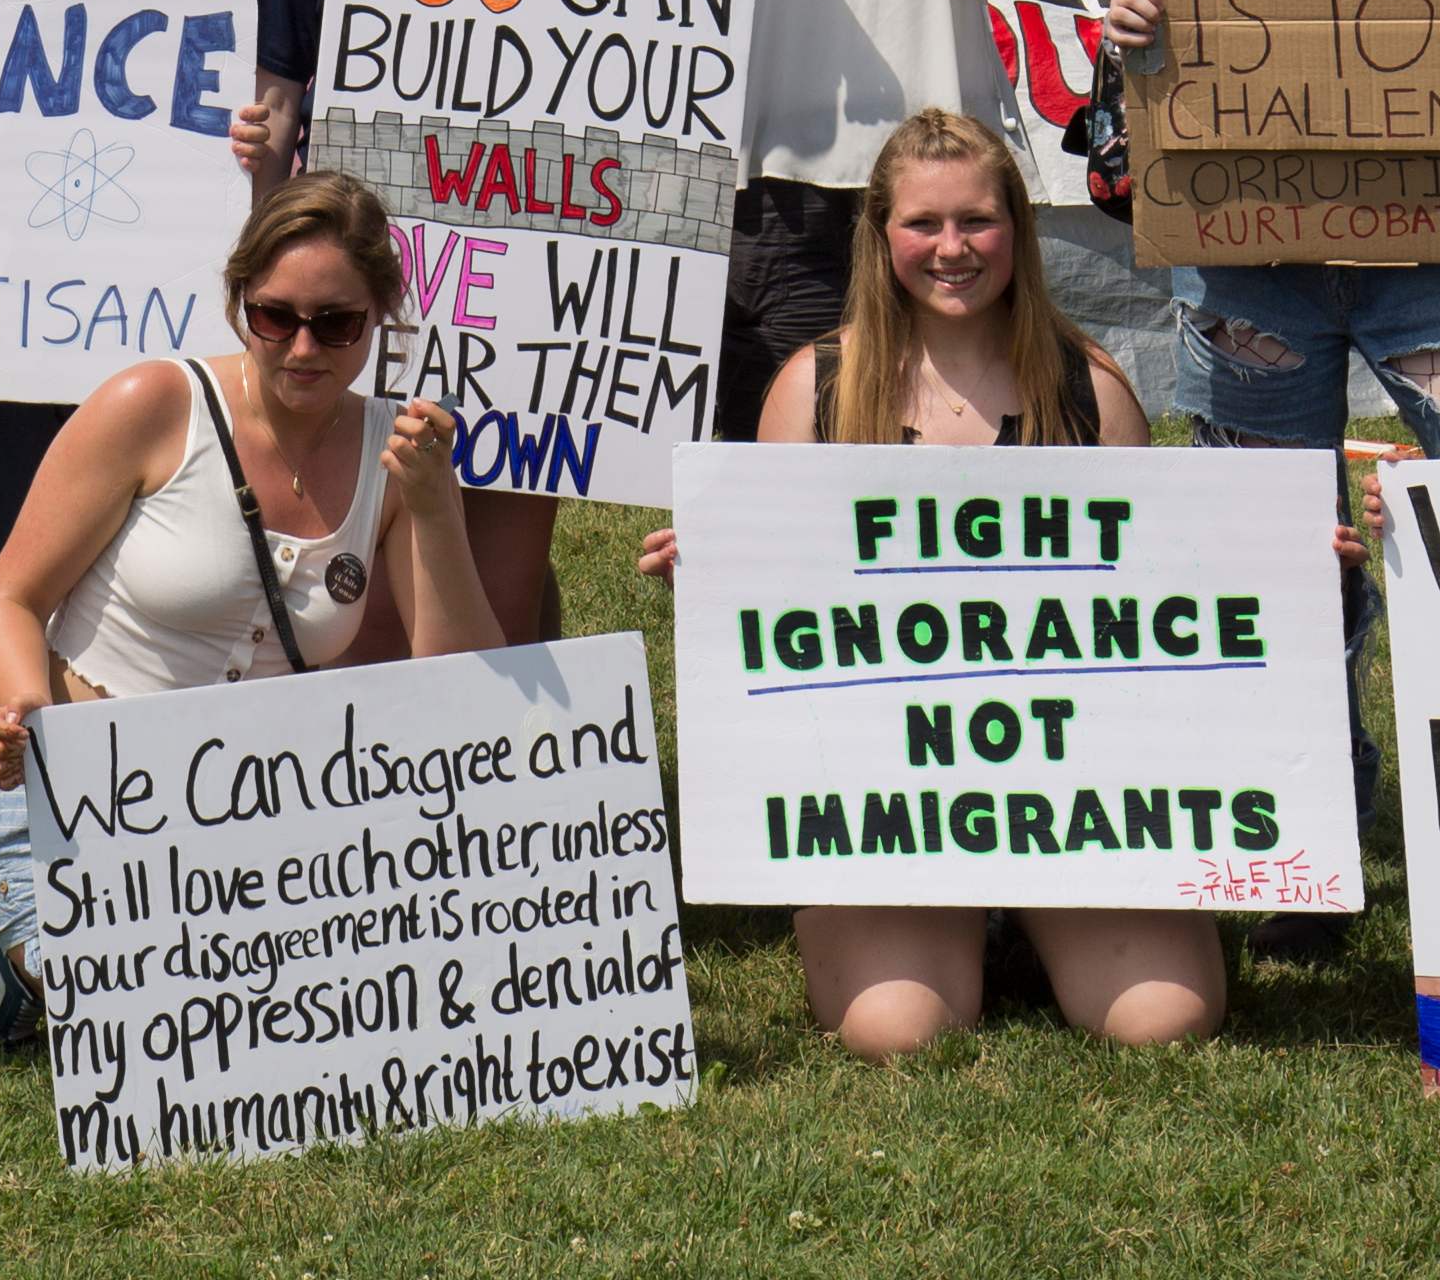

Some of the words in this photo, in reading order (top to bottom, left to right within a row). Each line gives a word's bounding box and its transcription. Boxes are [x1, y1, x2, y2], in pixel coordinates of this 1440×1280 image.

[334, 3, 532, 118] BUILD
[545, 27, 734, 139] YOUR
[425, 135, 621, 226] WALLS
[1195, 205, 1306, 248] KURT
[547, 241, 701, 357] WILL
[374, 324, 496, 410] EAR
[517, 342, 709, 440] THEM
[854, 496, 1132, 562] FIGHT
[738, 596, 1267, 671] IGNORANCE
[25, 721, 168, 841] We
[186, 738, 315, 829] Can
[321, 703, 516, 819] disagree
[529, 685, 648, 776] and
[905, 698, 1075, 767] NOT
[44, 857, 151, 937] Still
[169, 845, 263, 916] love
[551, 801, 668, 863] unless
[766, 789, 1280, 859] IMMIGRANTS
[1227, 858, 1293, 887] LET
[1203, 884, 1262, 901] THEM
[44, 944, 156, 1021] your
[164, 900, 421, 994] disagreement
[471, 870, 597, 935] rooted
[611, 875, 658, 918] in
[52, 1015, 125, 1103] my
[142, 963, 417, 1082] oppression
[439, 960, 475, 1028] &
[491, 930, 635, 1016] denial
[59, 1098, 140, 1167] my
[156, 1072, 376, 1158] humanity
[382, 1057, 414, 1132] &
[415, 1033, 521, 1128] right
[573, 1023, 693, 1090] exist
